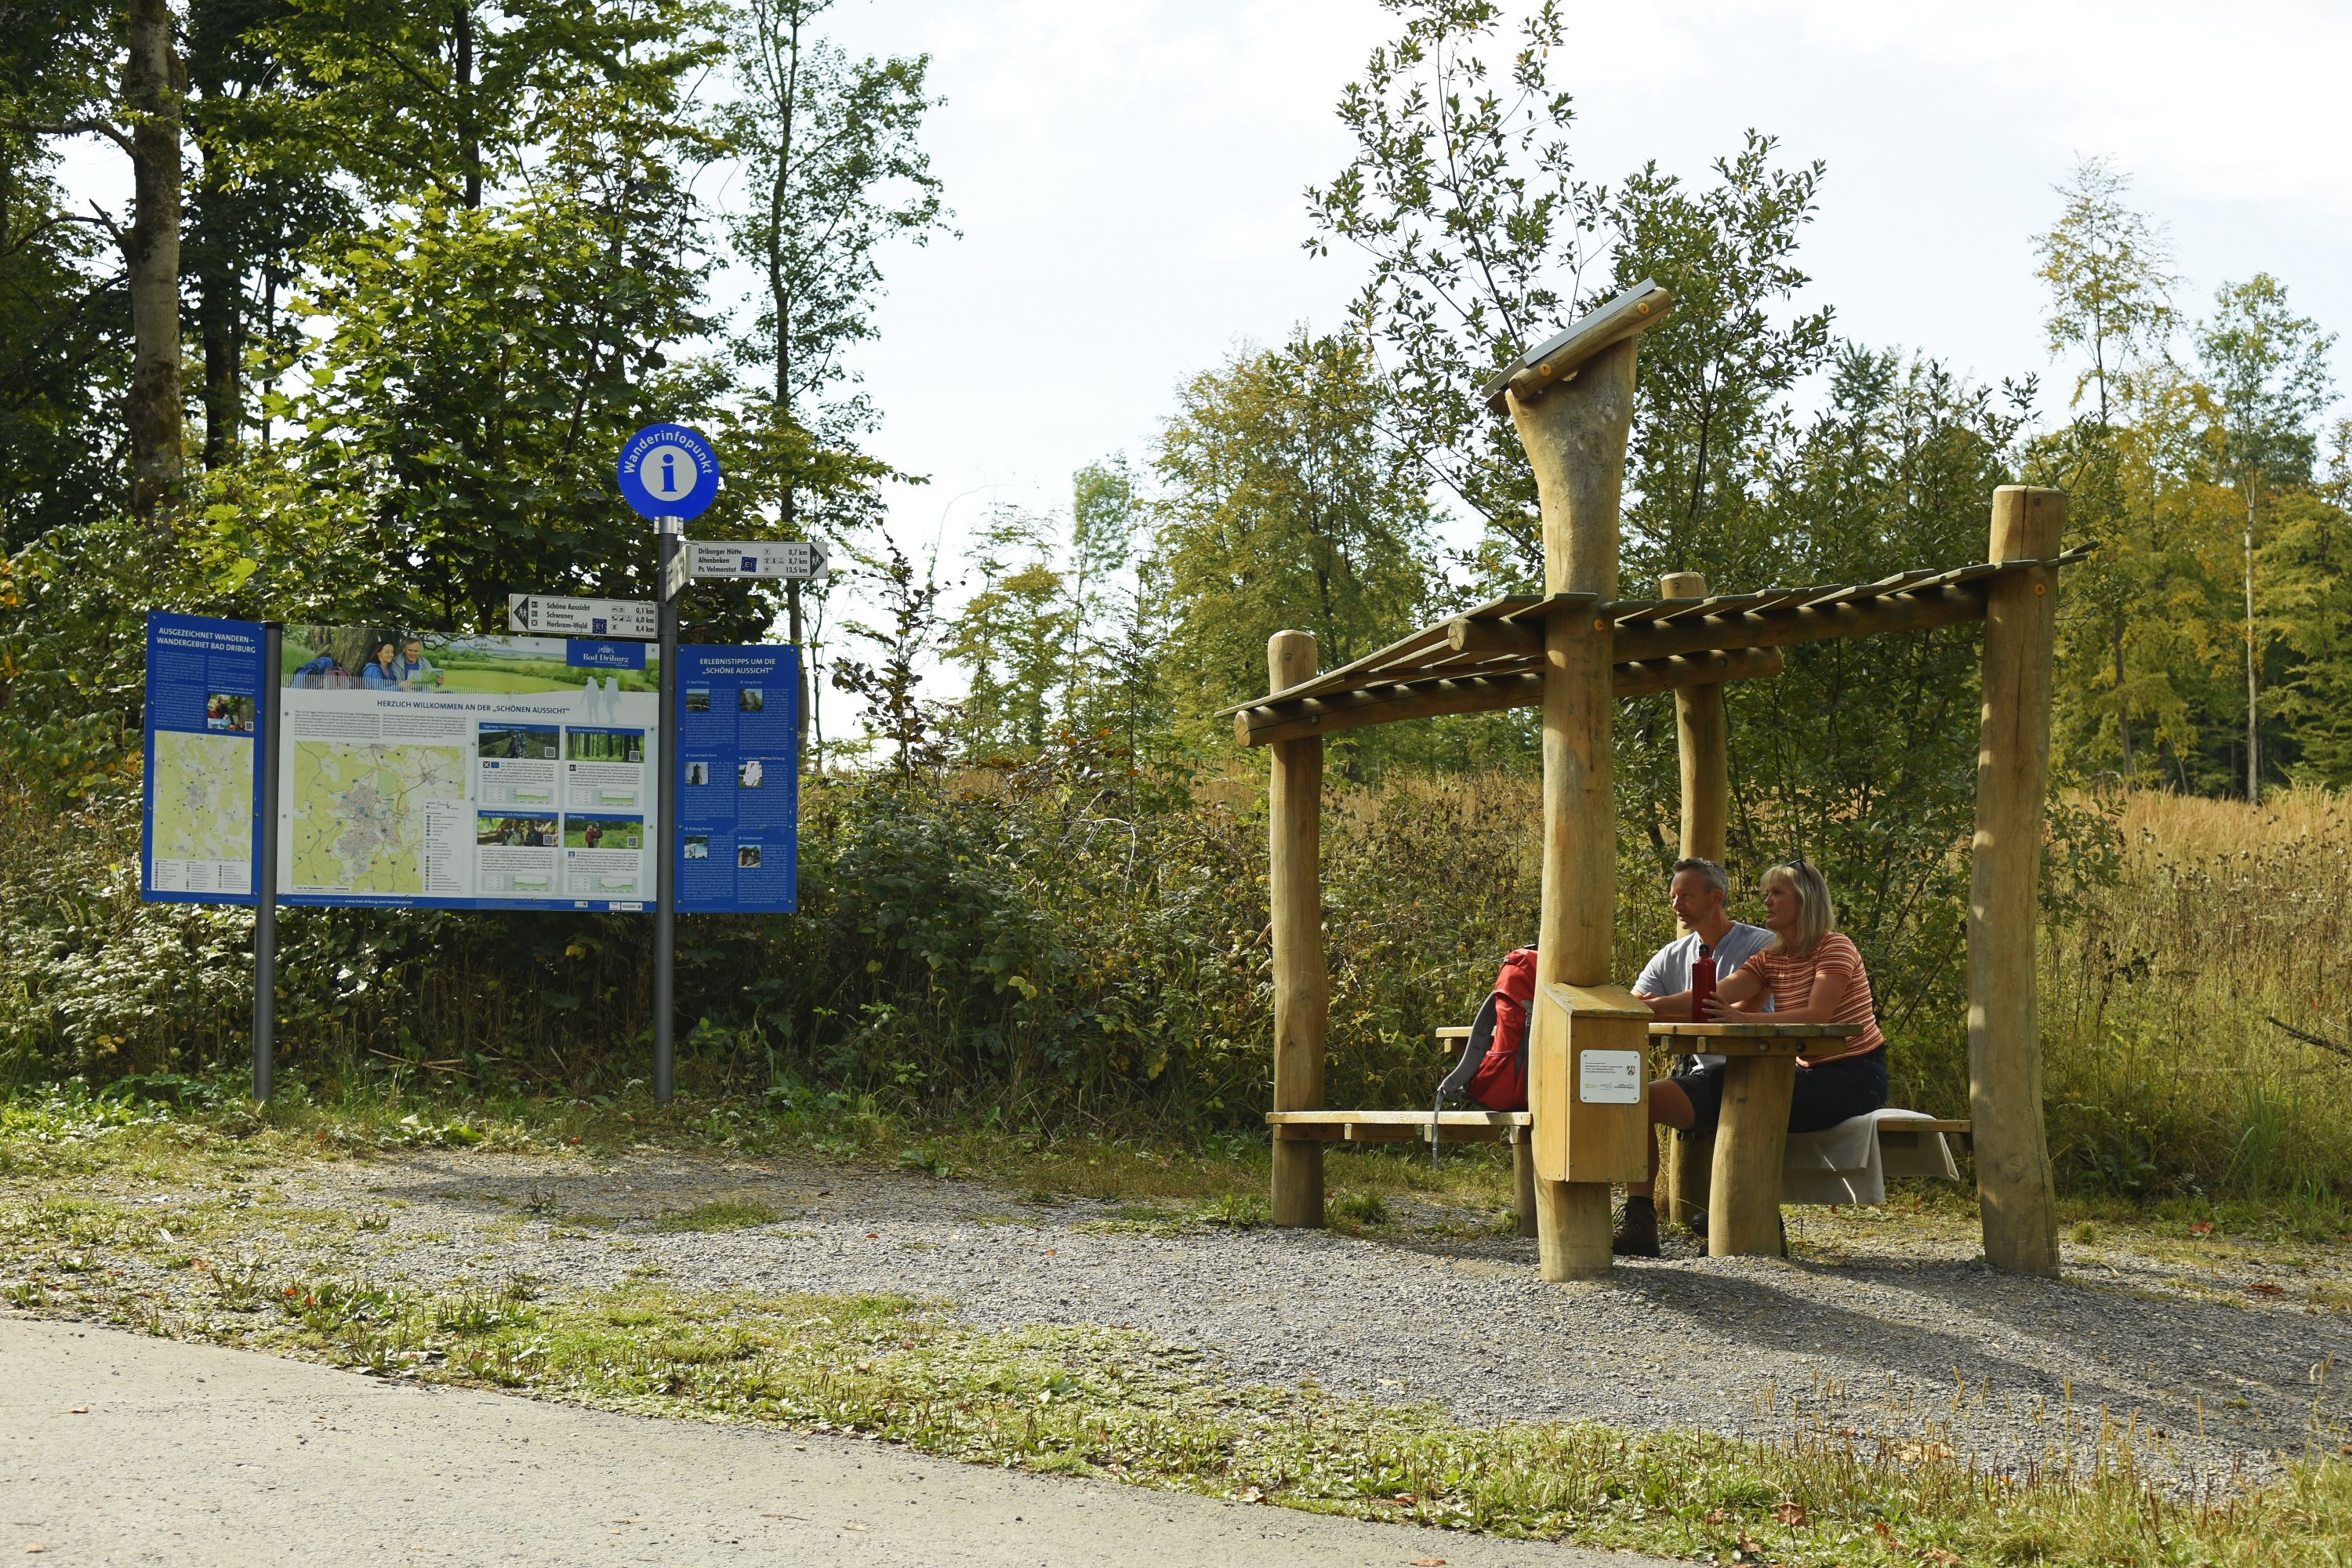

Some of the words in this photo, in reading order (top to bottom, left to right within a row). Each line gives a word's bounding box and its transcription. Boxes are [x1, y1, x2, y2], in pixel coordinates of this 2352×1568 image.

[623, 430, 713, 474] Wanderinfopunkt
[547, 612, 573, 620] Schwaney
[547, 621, 588, 630] Herbram-Wald
[159, 628, 213, 639] AUSGEZEICHNET
[215, 633, 249, 643] WANDERN
[157, 637, 209, 648] WANDERGEBIET
[226, 644, 256, 653] DRIBURG
[600, 654, 629, 662] Driburg
[702, 666, 734, 674] „SCHÖNE
[493, 704, 531, 713] „SCHÖNEN
